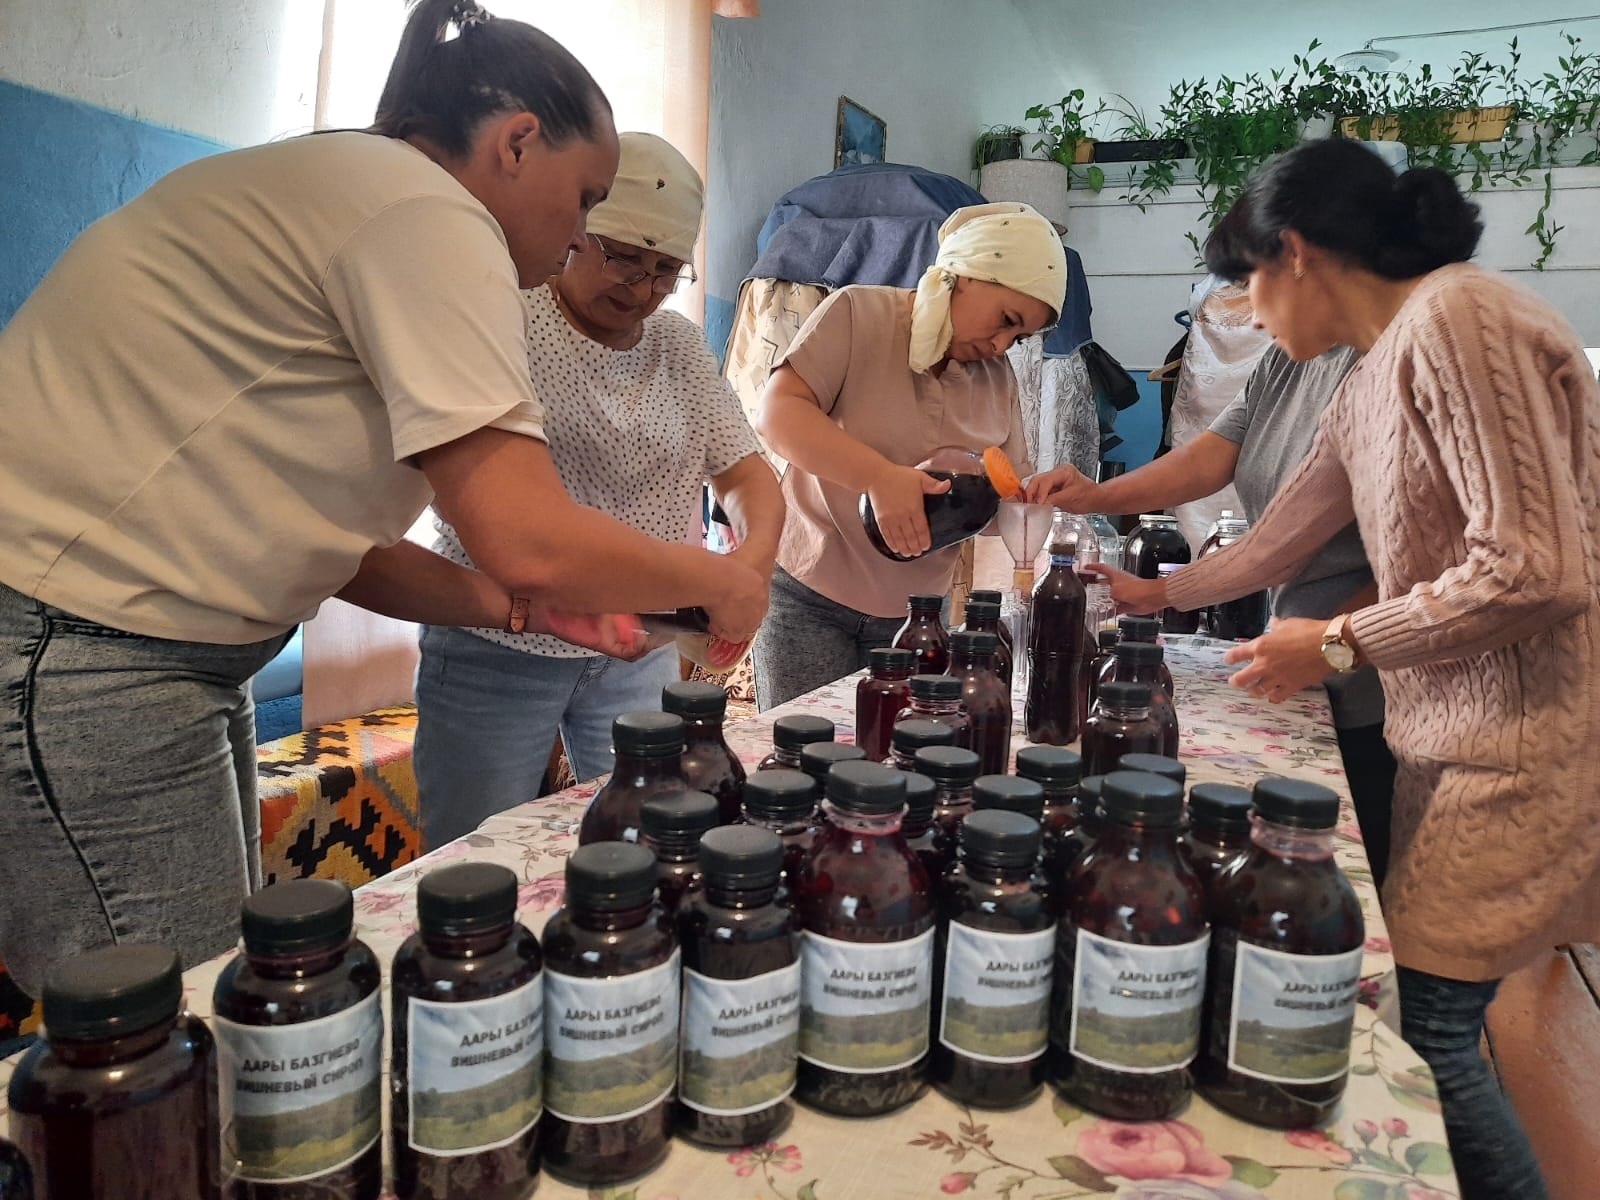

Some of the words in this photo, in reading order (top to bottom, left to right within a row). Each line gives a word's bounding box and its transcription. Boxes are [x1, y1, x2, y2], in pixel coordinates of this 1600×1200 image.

[564, 1007, 601, 1021] ДАРЫ
[718, 1004, 752, 1020] ДАРЫ
[460, 1027, 503, 1048] ДАРЫ
[241, 1058, 285, 1072] ДАРЫ
[321, 1057, 363, 1085] СИРОП
